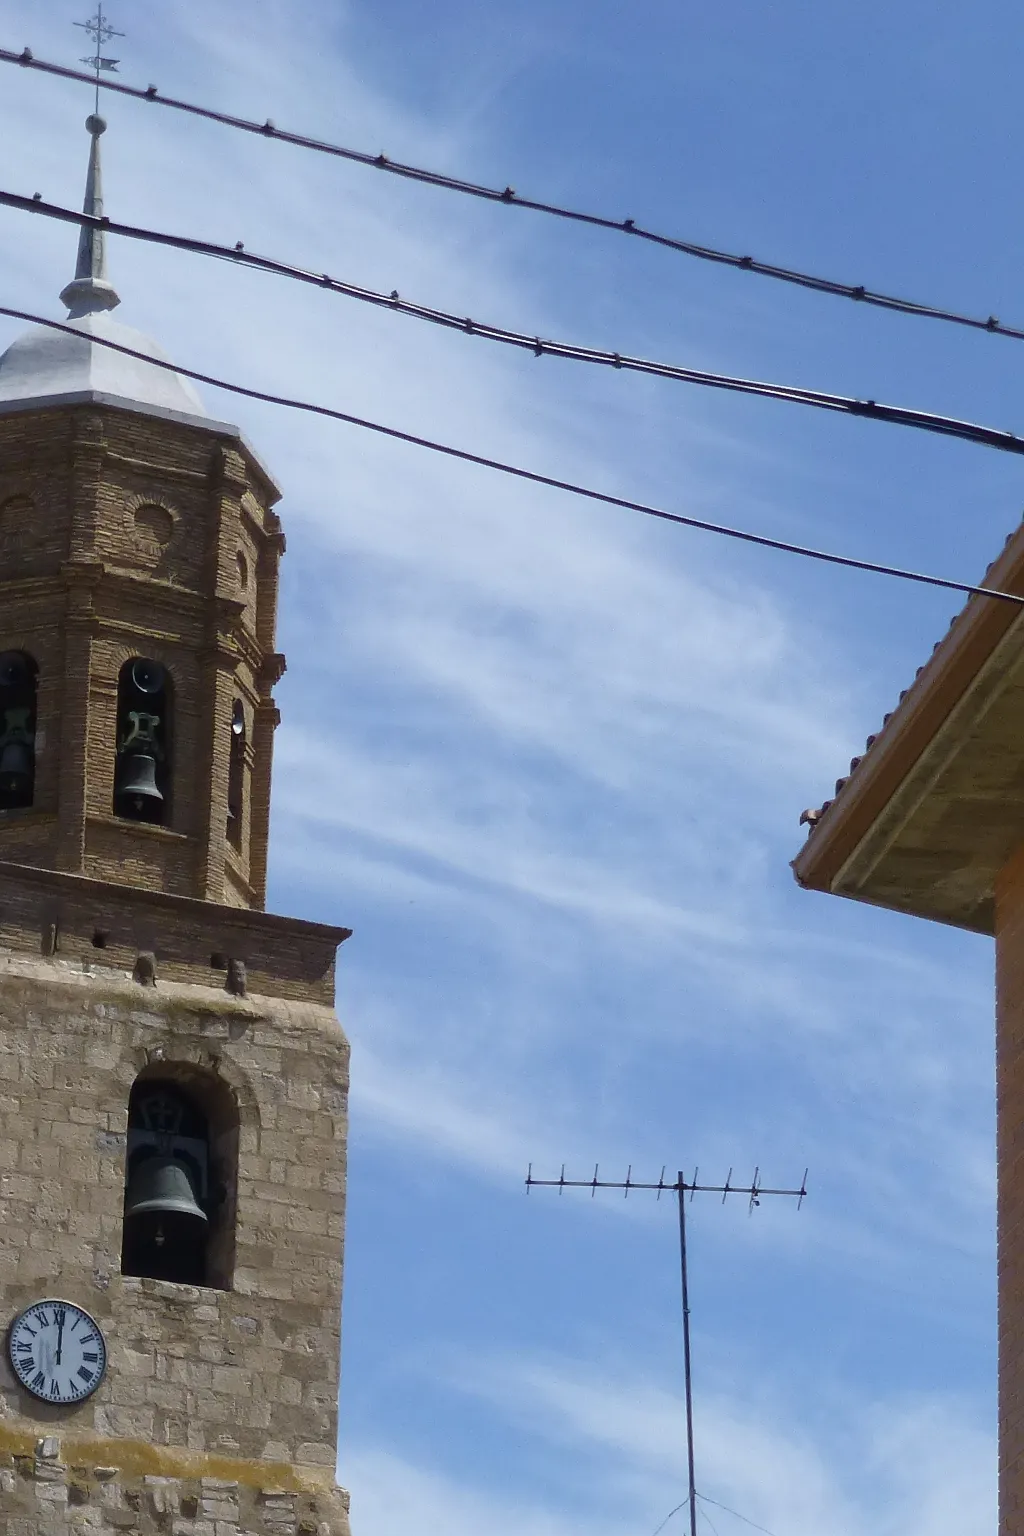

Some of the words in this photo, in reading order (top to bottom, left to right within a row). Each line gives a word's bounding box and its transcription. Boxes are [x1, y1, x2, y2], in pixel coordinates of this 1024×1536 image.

[34, 1311, 49, 1329] XI
[22, 1323, 37, 1337] X
[79, 1333, 95, 1345] II
[17, 1341, 32, 1353] IX
[82, 1352, 98, 1363] III
[50, 1378, 60, 1396] VI
[69, 1379, 79, 1394] V
